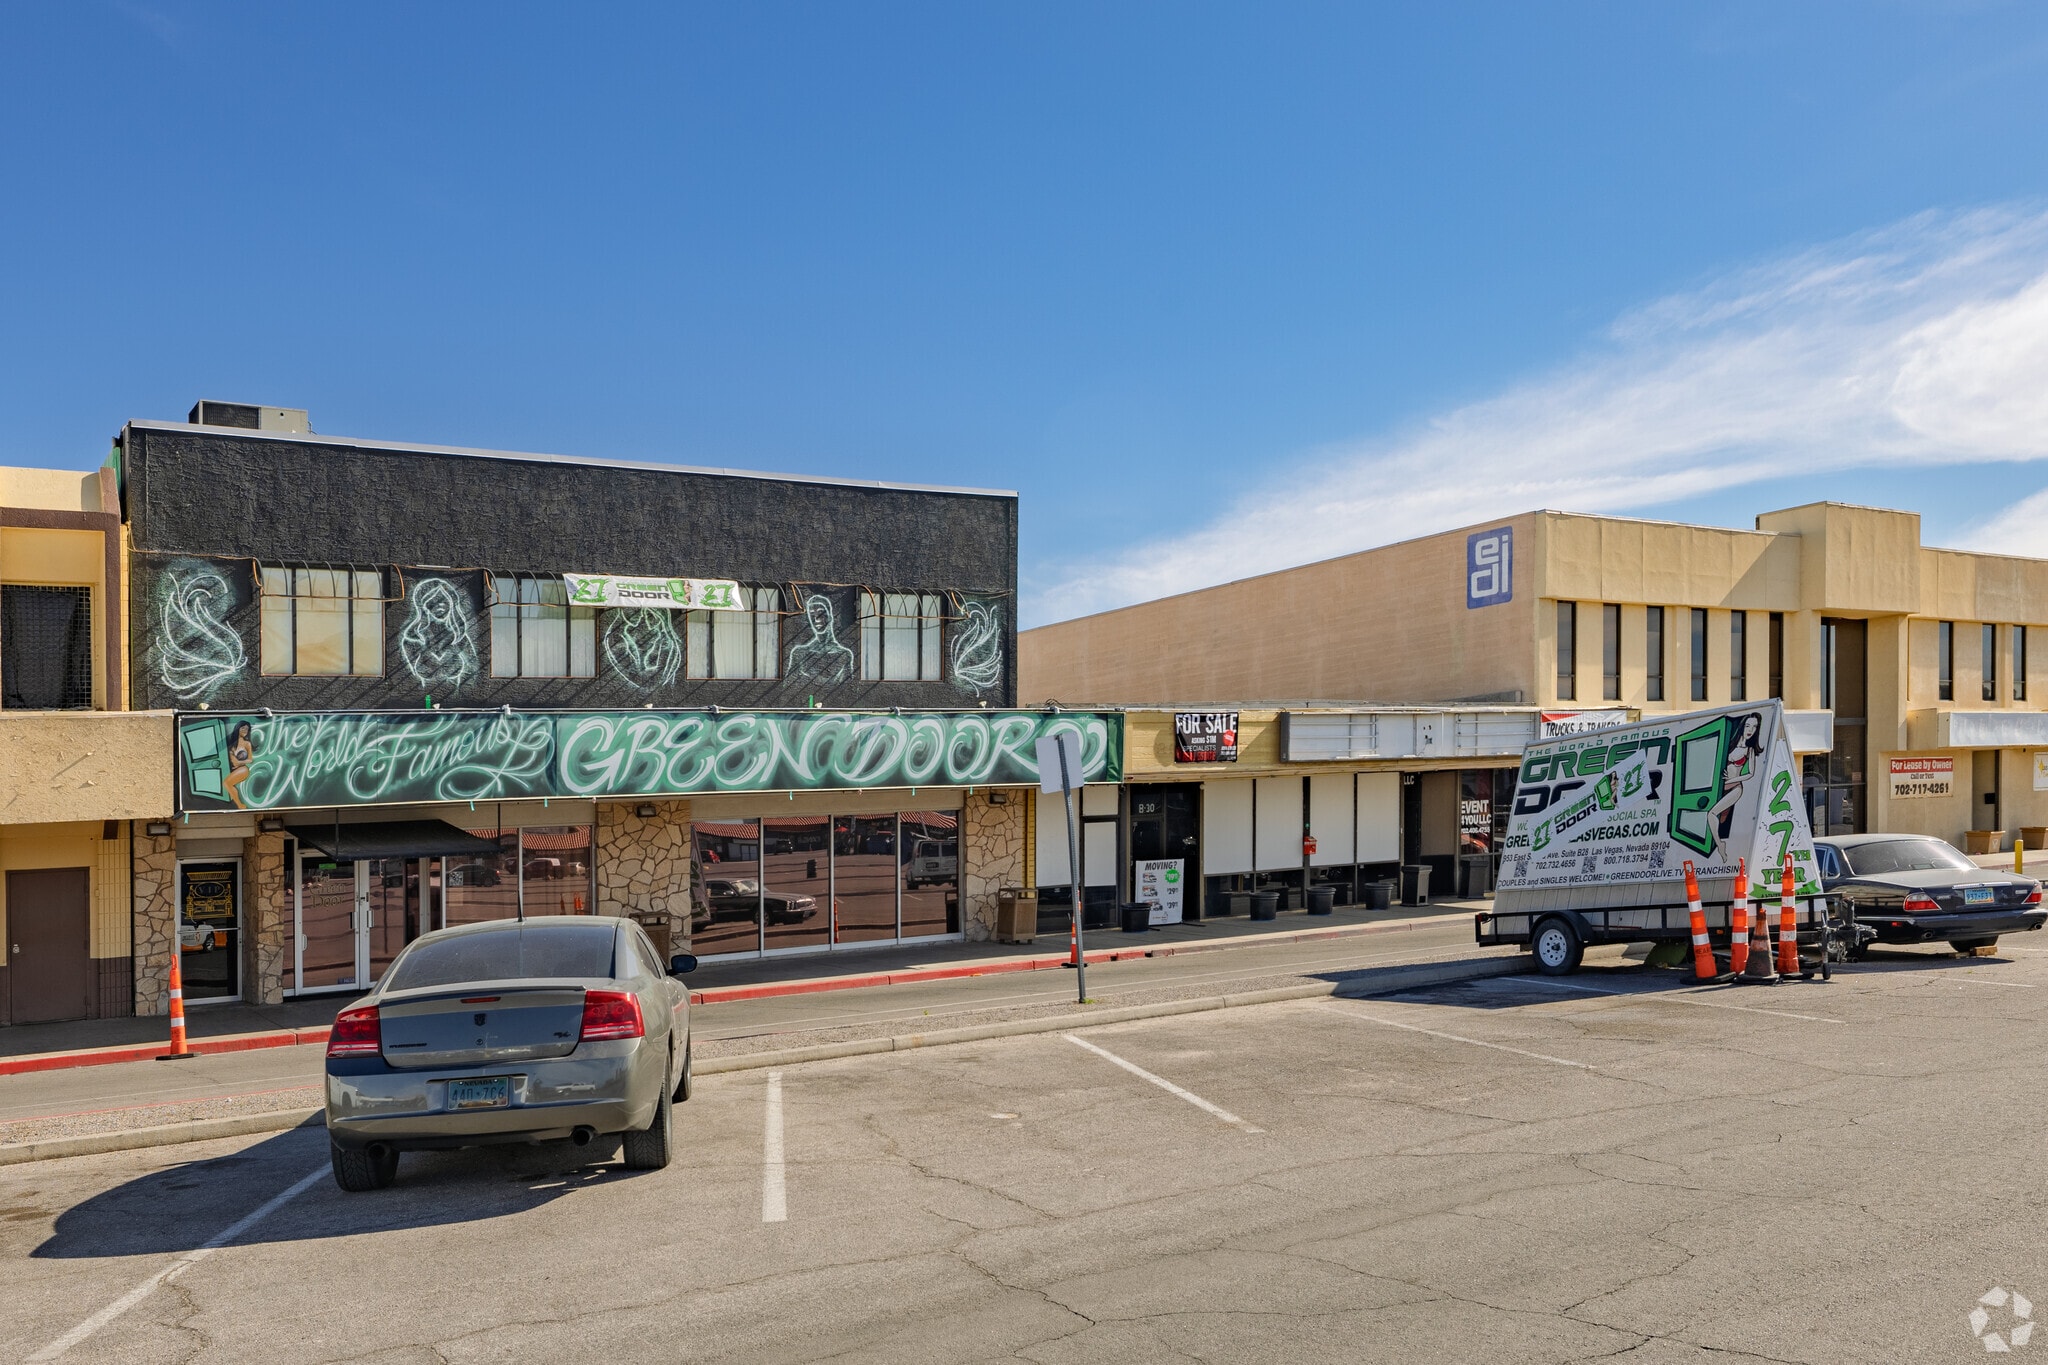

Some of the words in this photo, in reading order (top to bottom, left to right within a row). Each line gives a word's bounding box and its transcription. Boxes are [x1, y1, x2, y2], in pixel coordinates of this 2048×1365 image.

[573, 579, 609, 602] 27
[616, 582, 668, 592] GREEN
[618, 589, 671, 600] DOOR
[700, 583, 734, 607] 27
[1175, 713, 1201, 734] FOR
[1205, 713, 1238, 734] SALE
[1546, 722, 1575, 737] TRUCKS
[1578, 722, 1584, 733] &
[250, 714, 312, 758] The
[1528, 747, 1552, 757] THE
[1558, 739, 1603, 752] WORLD
[1611, 728, 1670, 744] FAMOUS
[240, 714, 366, 807] World
[347, 713, 554, 800] Famous
[561, 714, 848, 794] GREEN
[1891, 761, 1903, 770] For
[1903, 761, 1922, 770] Lease
[1922, 760, 1932, 771] by
[1932, 760, 1952, 769] Owner
[1403, 775, 1415, 785] LLC
[1622, 760, 1646, 798] 27
[1461, 800, 1489, 814] EVENT
[1554, 792, 1597, 825] GREEN
[1640, 808, 1657, 819] SPA
[1478, 813, 1492, 825] LLC
[1555, 803, 1598, 835] DOOR
[1531, 818, 1552, 852] 27
[1560, 850, 1576, 858] Suite
[1591, 847, 1603, 856] Las
[1604, 846, 1625, 856] Vegas,
[1625, 843, 1650, 853] Nevada
[1650, 841, 1671, 851] 89104
[1145, 861, 1178, 871] MOVING?
[1535, 859, 1577, 870] 702.732.4656
[1603, 854, 1649, 865] 800.718.3794
[1498, 878, 1526, 887] COUPLES
[1527, 877, 1538, 886] and
[1539, 875, 1568, 885] SINGLES
[1568, 873, 1605, 883] WELCOME!
[1610, 868, 1684, 880] GREENDOORLIVE.TV
[1761, 867, 1806, 885] YER
[199, 884, 222, 894] VIP
